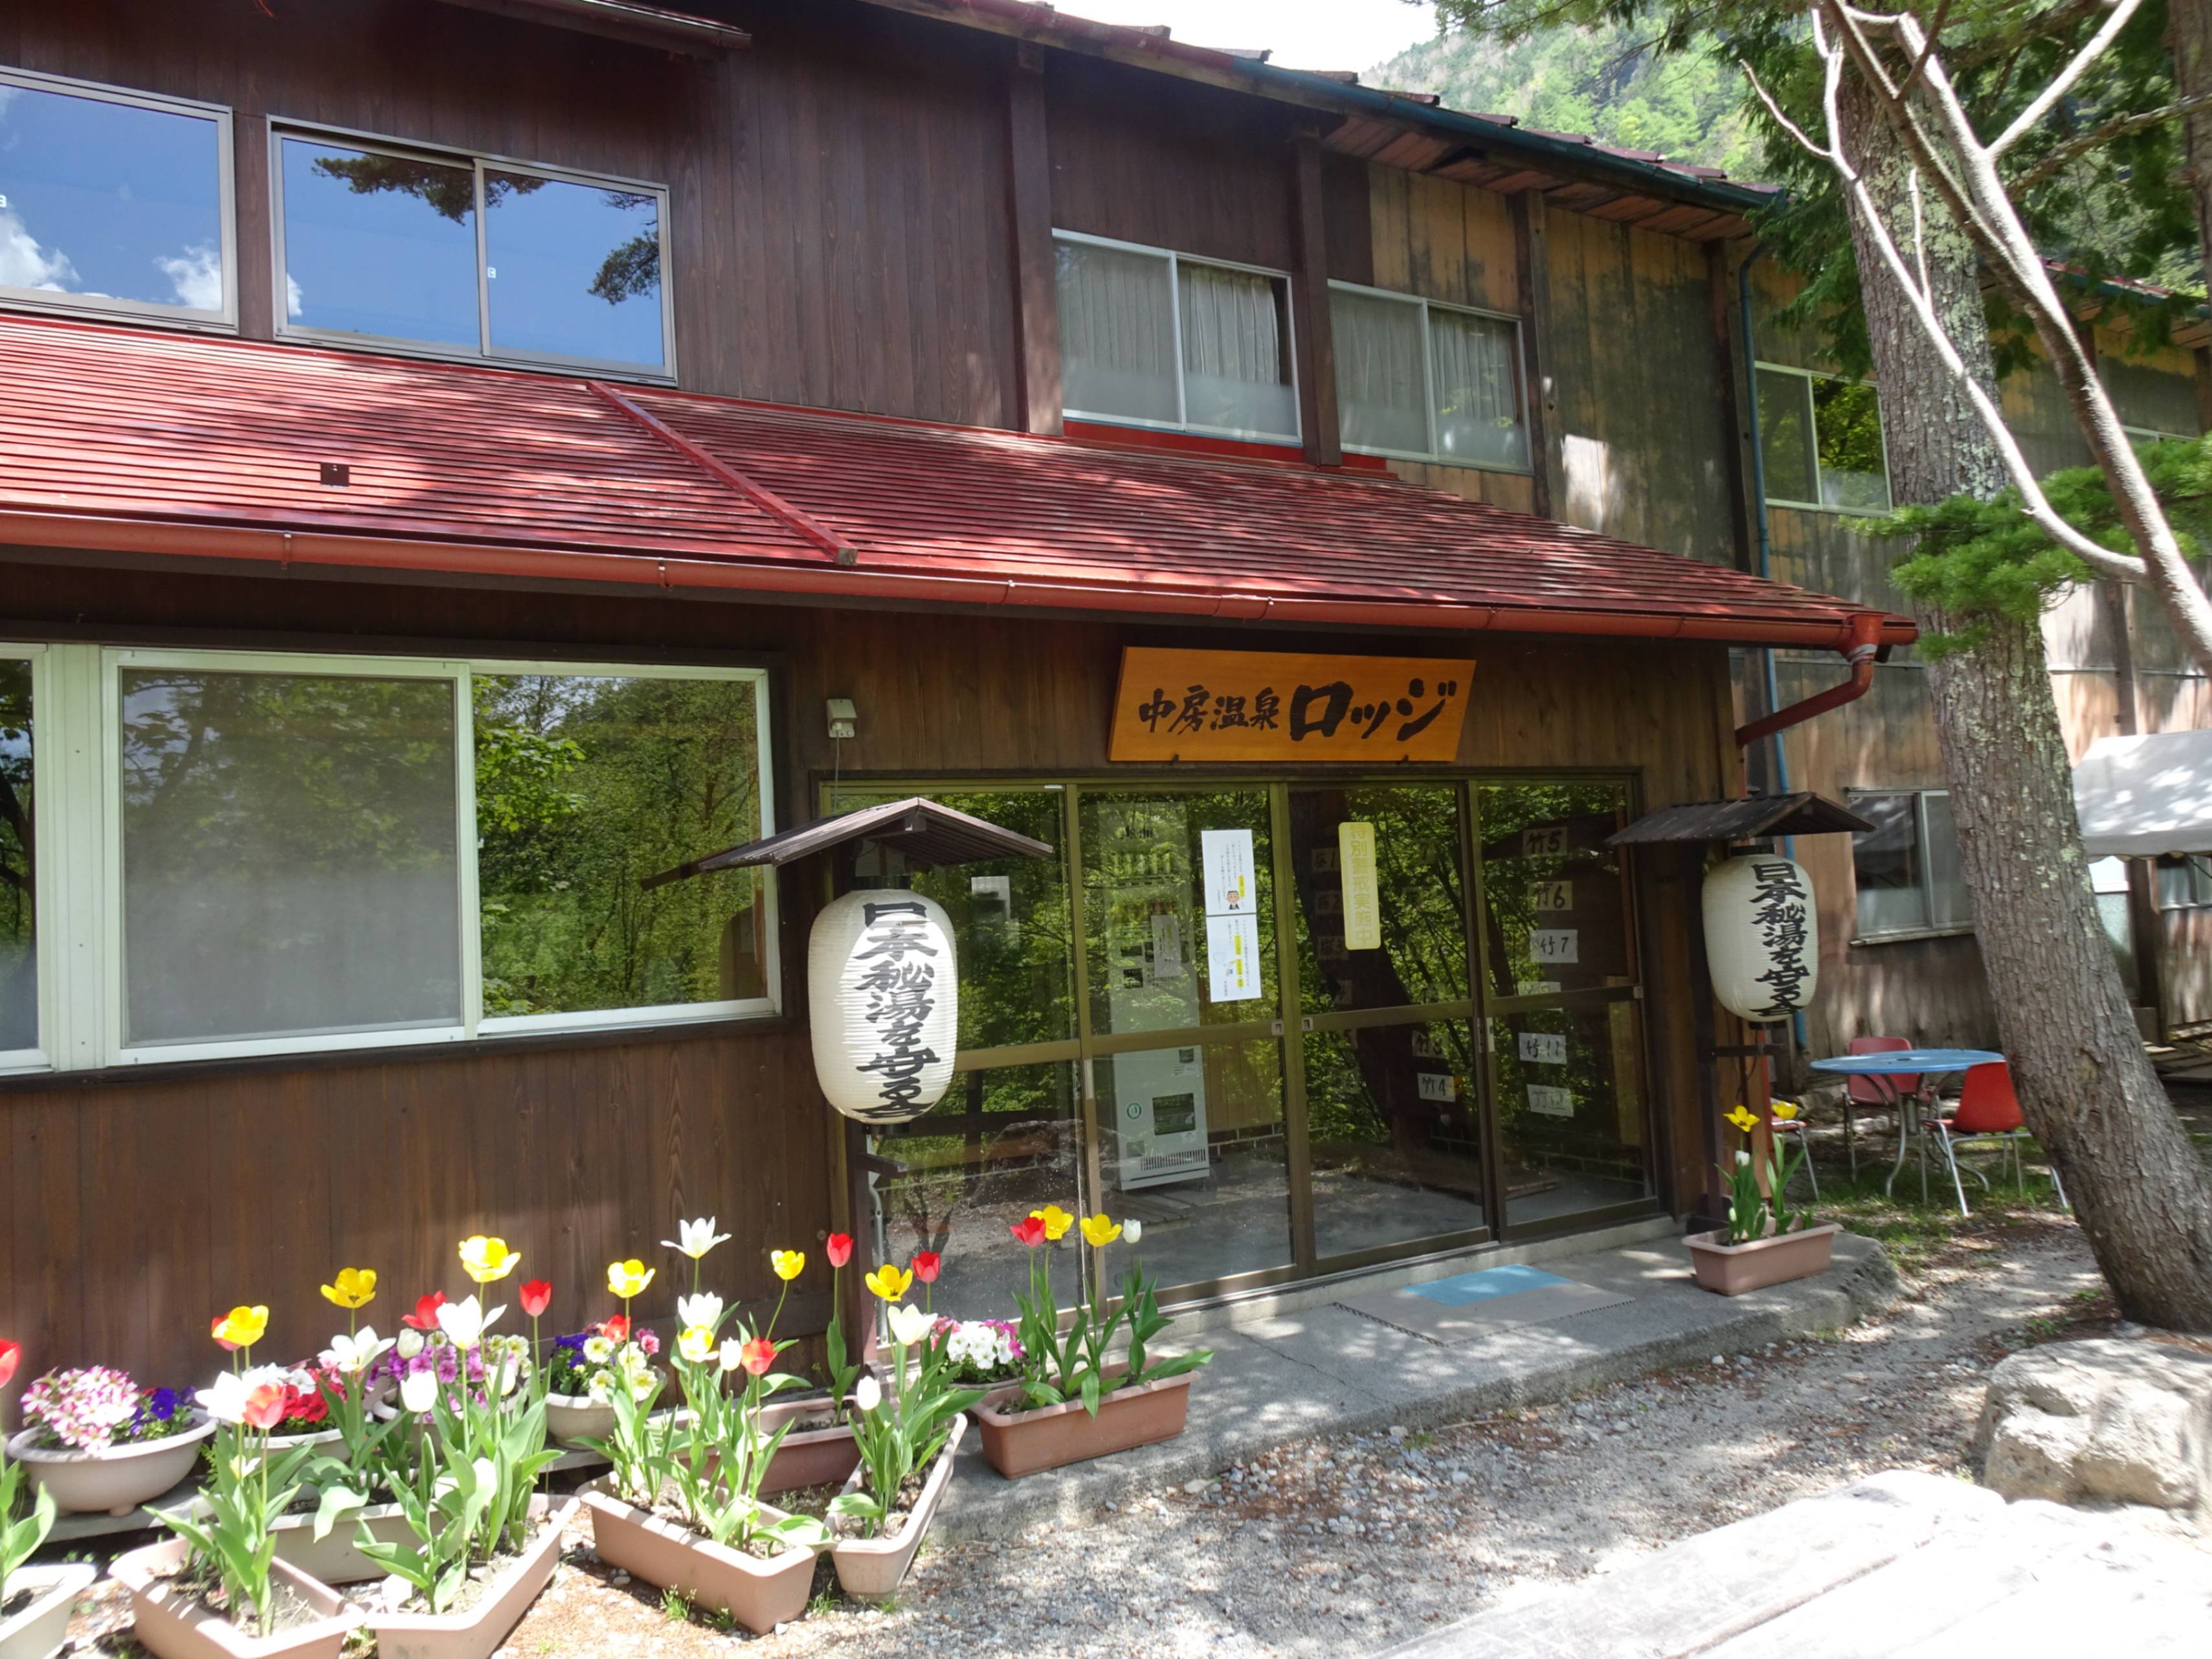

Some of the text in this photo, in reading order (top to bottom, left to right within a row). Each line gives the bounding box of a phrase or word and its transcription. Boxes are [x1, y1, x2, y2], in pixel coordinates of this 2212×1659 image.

[1139, 678, 1457, 741] 中房温泉ロッジ
[850, 901, 941, 1119] 日本秘湯を守る会
[1748, 862, 1810, 1017] 日本秘湯を守る会
